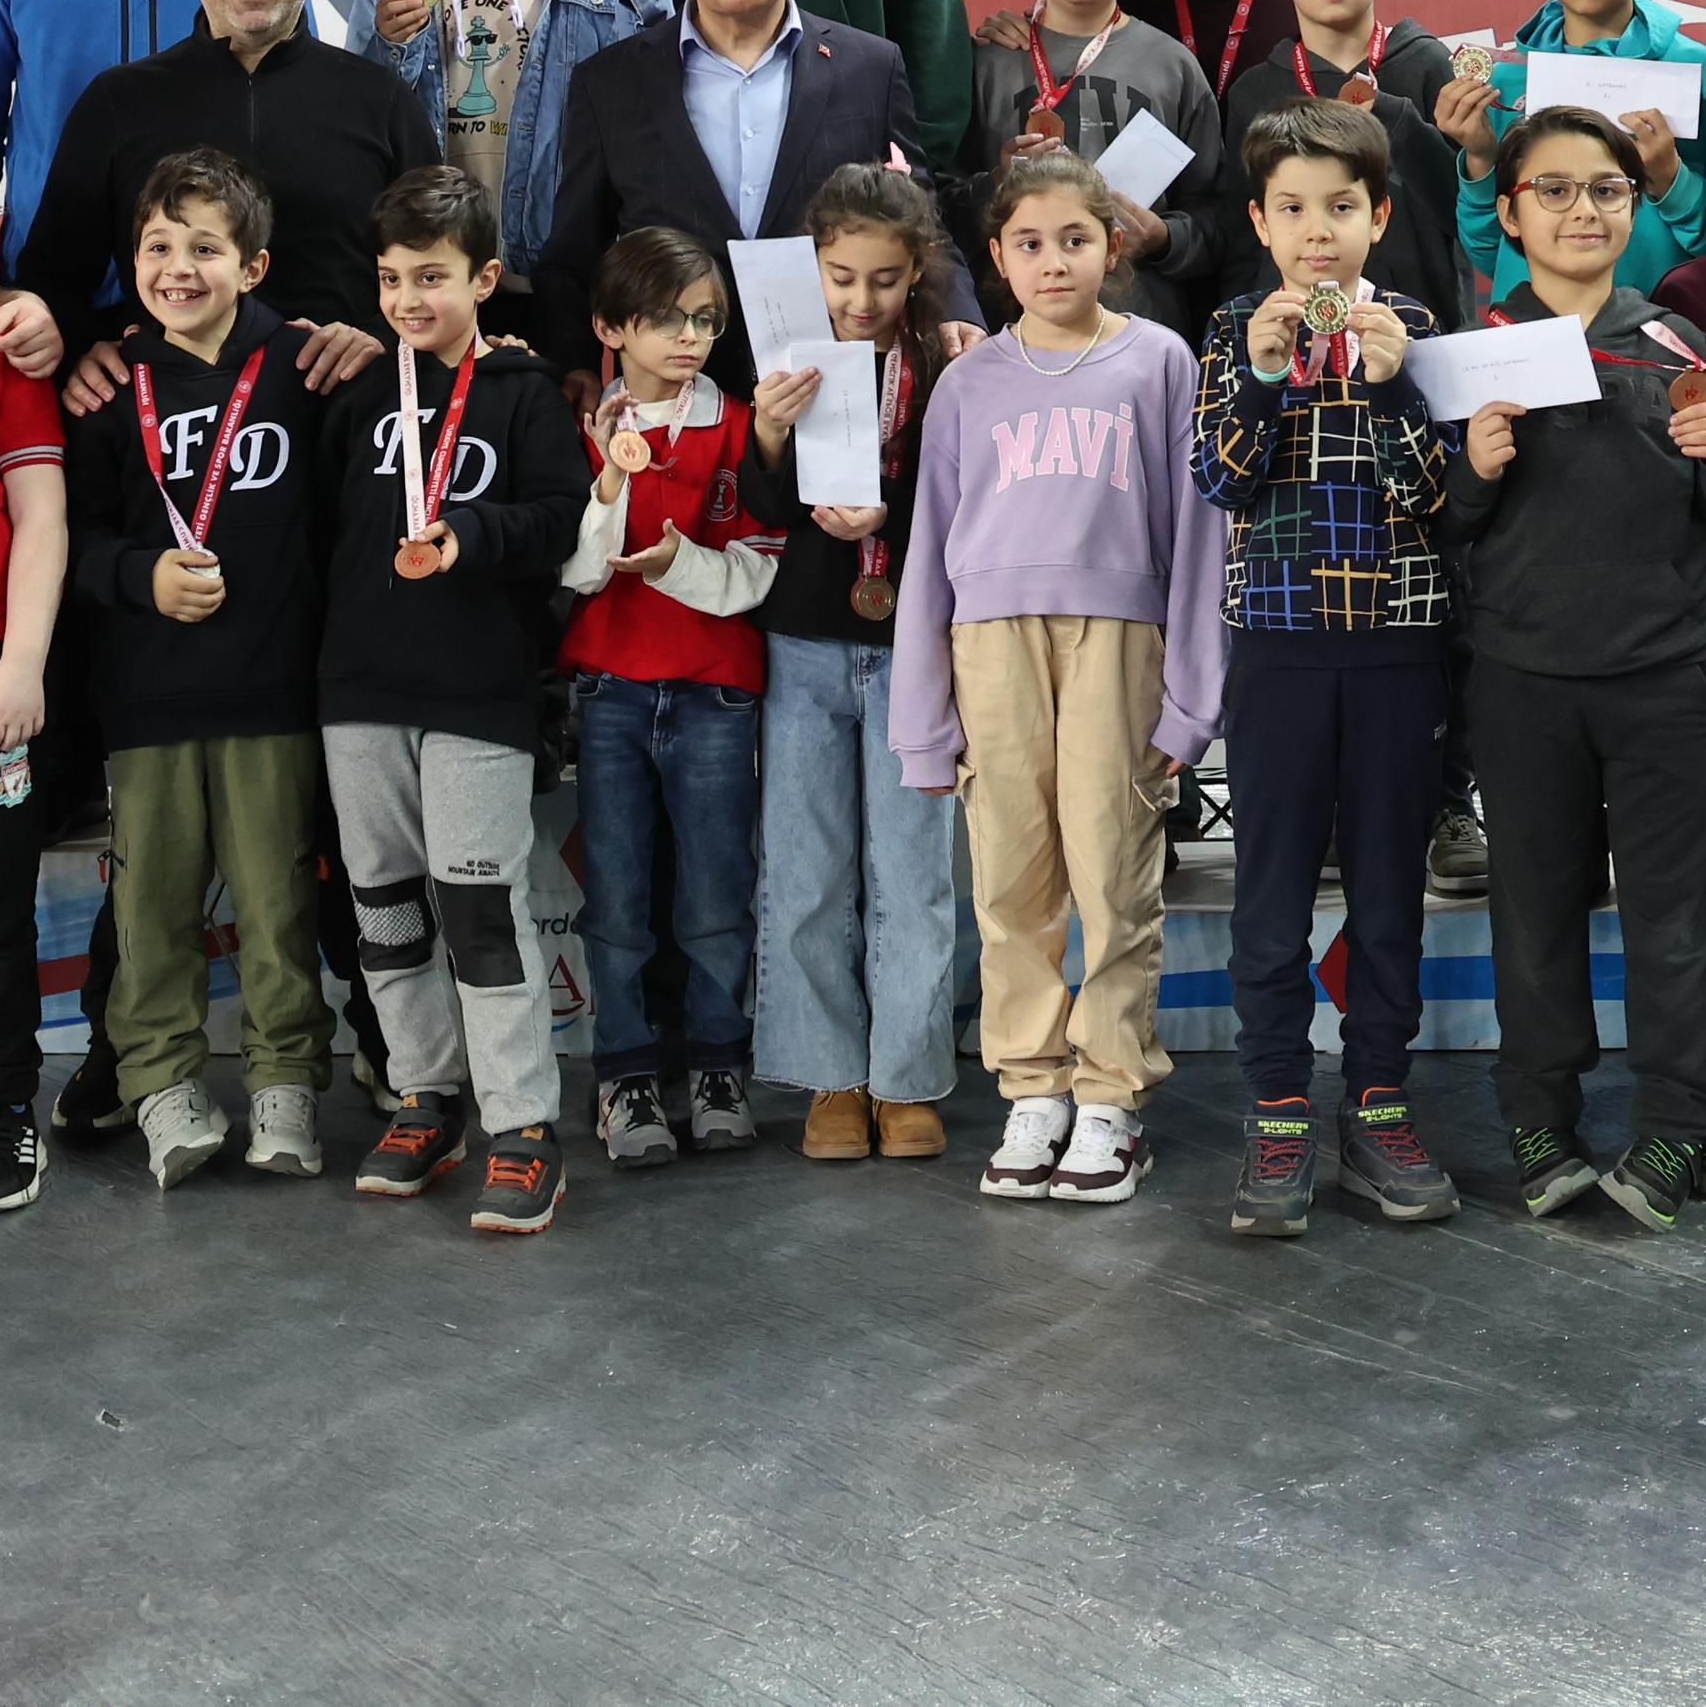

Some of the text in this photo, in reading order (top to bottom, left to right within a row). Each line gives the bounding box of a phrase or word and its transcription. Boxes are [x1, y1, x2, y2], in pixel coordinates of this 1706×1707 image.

[470, 120, 486, 134] TO
[222, 399, 243, 446] BAKANLIĞI
[158, 405, 290, 491] F D
[990, 402, 1135, 494] MAVİ
[215, 446, 228, 470] SPOR
[210, 468, 221, 483] VE
[199, 483, 217, 521] GENÇLİK
[448, 866, 475, 876] MOUNTAIN
[1357, 1105, 1408, 1119] SKECHERS
[1257, 1120, 1309, 1130] SKECHERS
